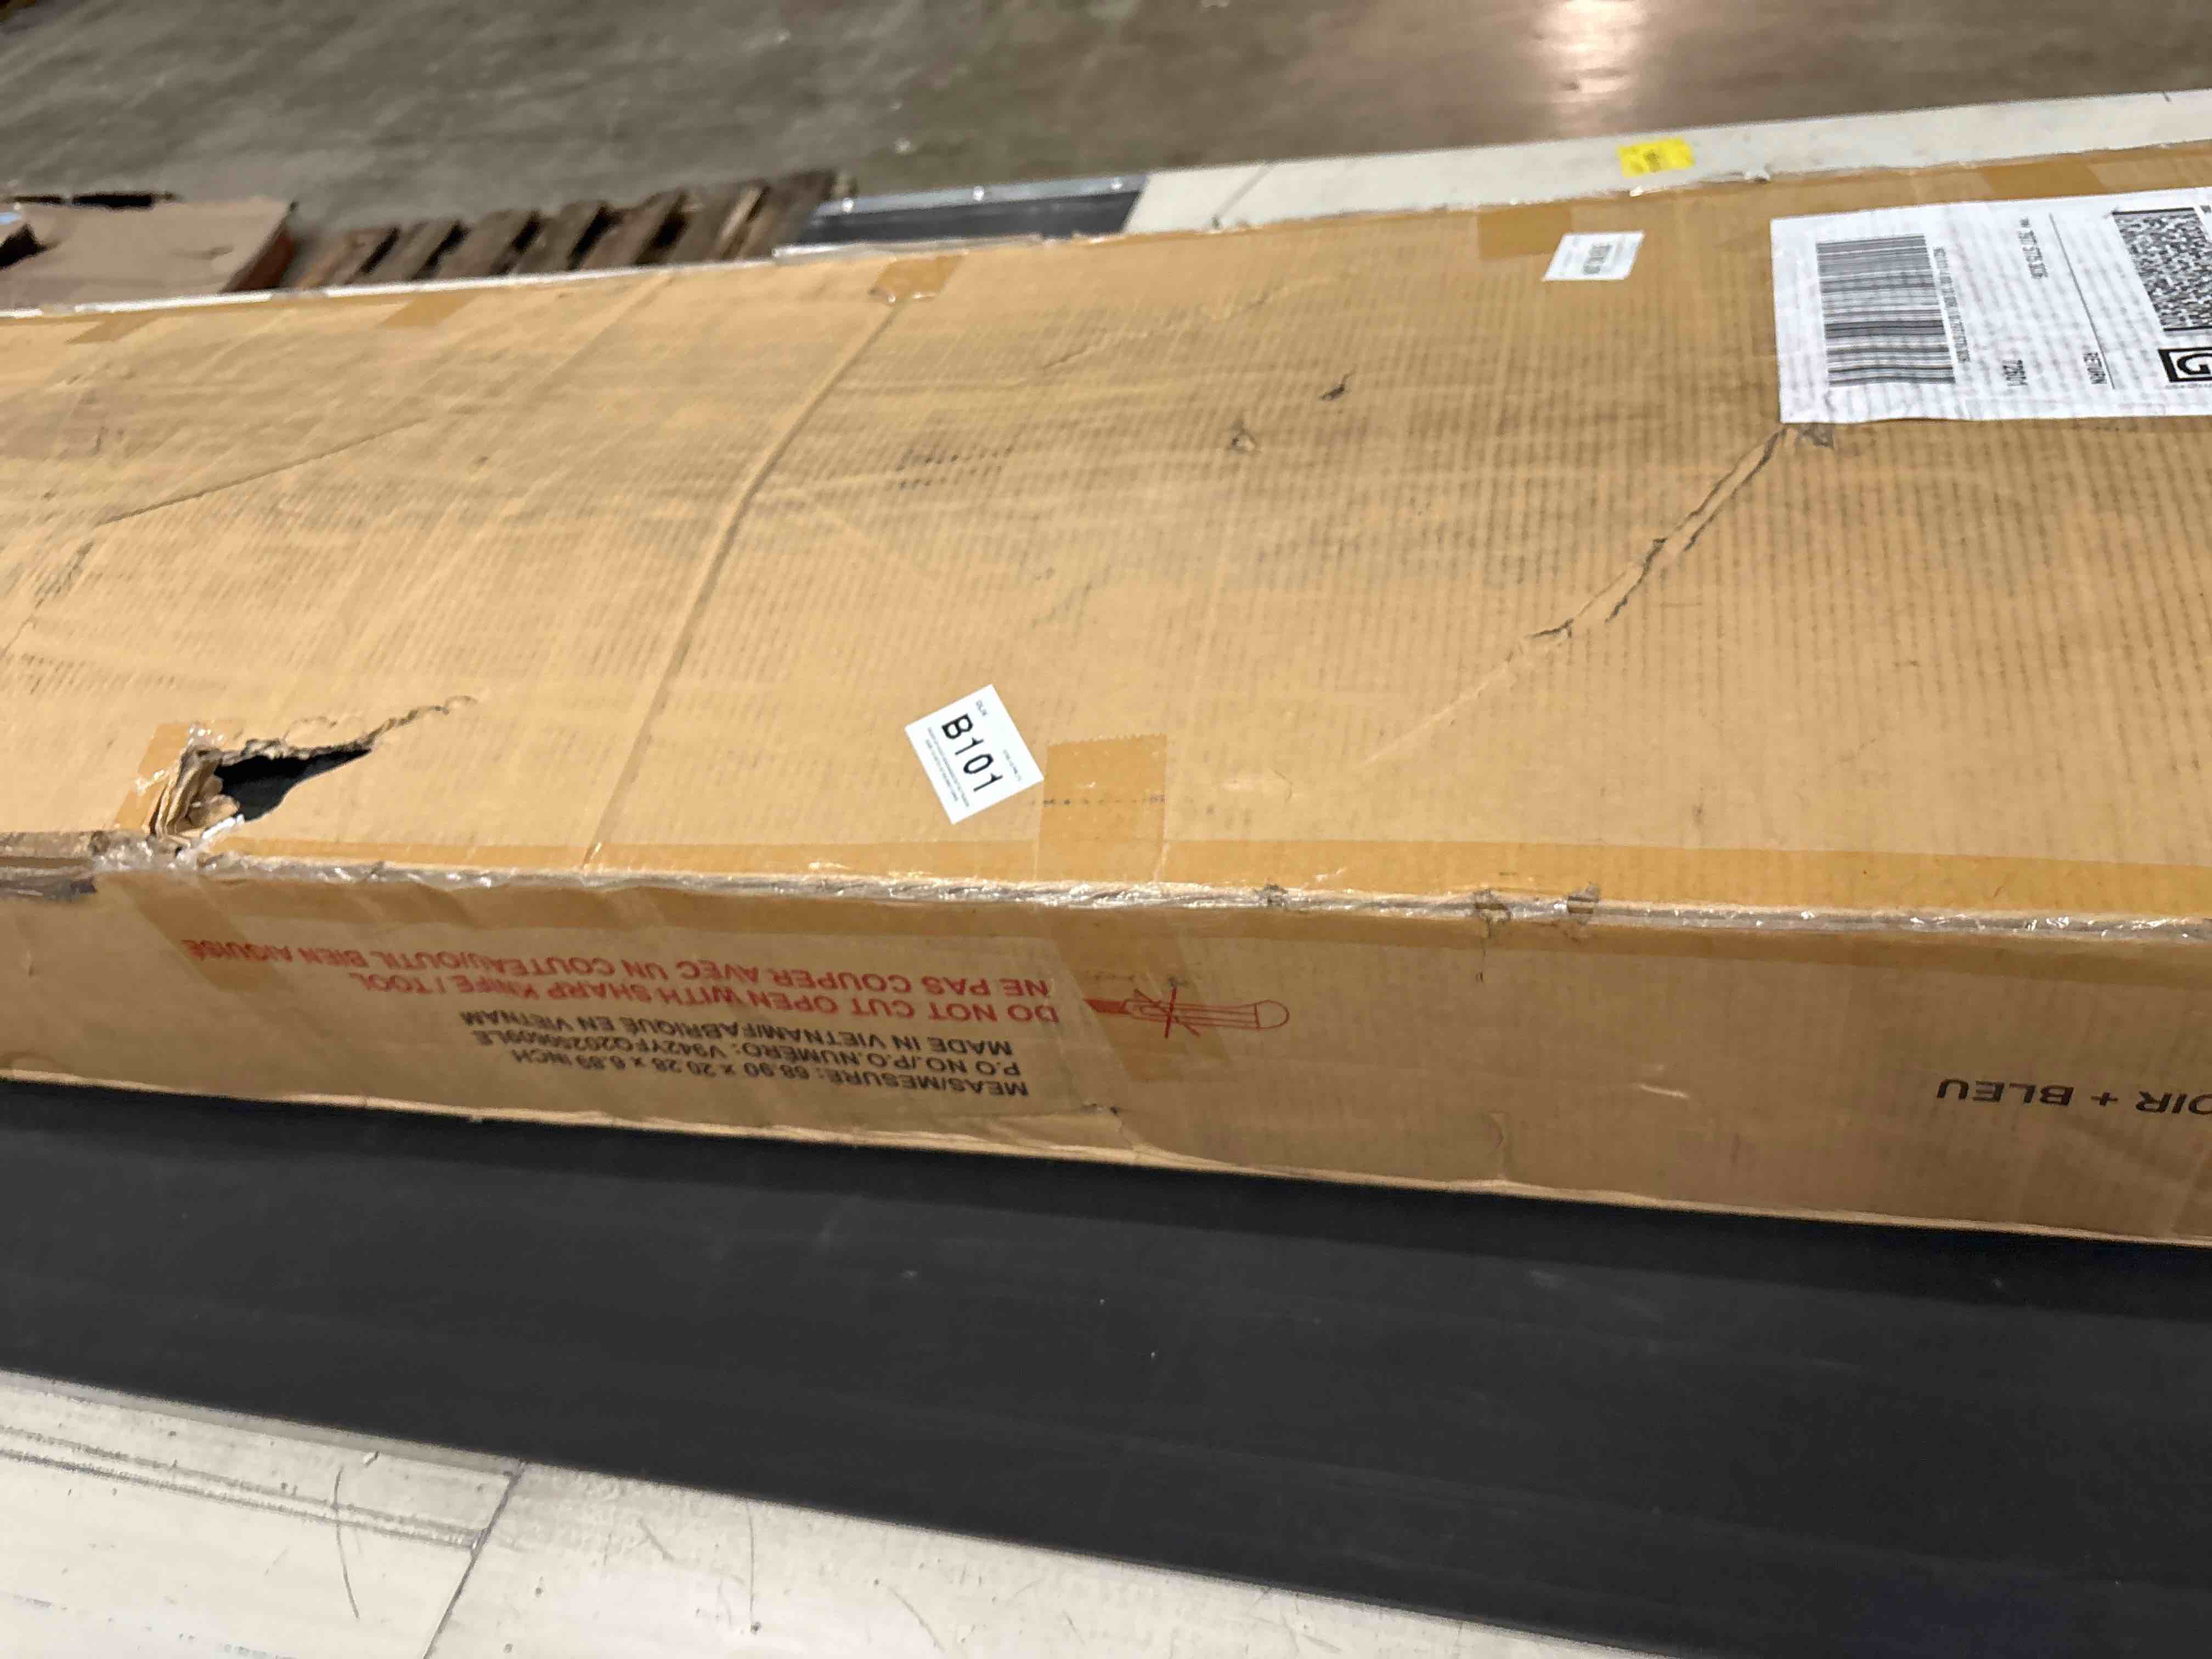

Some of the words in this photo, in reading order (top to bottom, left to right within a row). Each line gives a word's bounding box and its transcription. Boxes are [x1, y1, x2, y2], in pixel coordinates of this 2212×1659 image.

[941, 713, 1003, 792] B101
[297, 947, 369, 968] BIEN
[621, 960, 670, 983] UN
[675, 960, 761, 985] AVEC
[767, 967, 912, 995] COUPER
[347, 972, 433, 995] TOOL
[546, 981, 652, 1005] SHARP
[921, 975, 991, 997] PAS
[998, 978, 1050, 1000] NE
[656, 986, 744, 1010] WITH
[746, 990, 839, 1014] OPEN
[850, 997, 916, 1019] CUT
[458, 1010, 574, 1032] VIETNAM
[928, 1002, 998, 1023] NOT
[1006, 1004, 1059, 1025] DO
[577, 1016, 615, 1032] EN
[891, 1034, 922, 1052] IN
[927, 1036, 1014, 1057] MADE
[511, 1048, 573, 1066] INCH
[742, 1062, 810, 1081] 68.90
[975, 1060, 1022, 1077] P.O
[817, 1068, 1029, 1097] MEAS/MESURE:
[1936, 1077, 2074, 1108] BLEU
